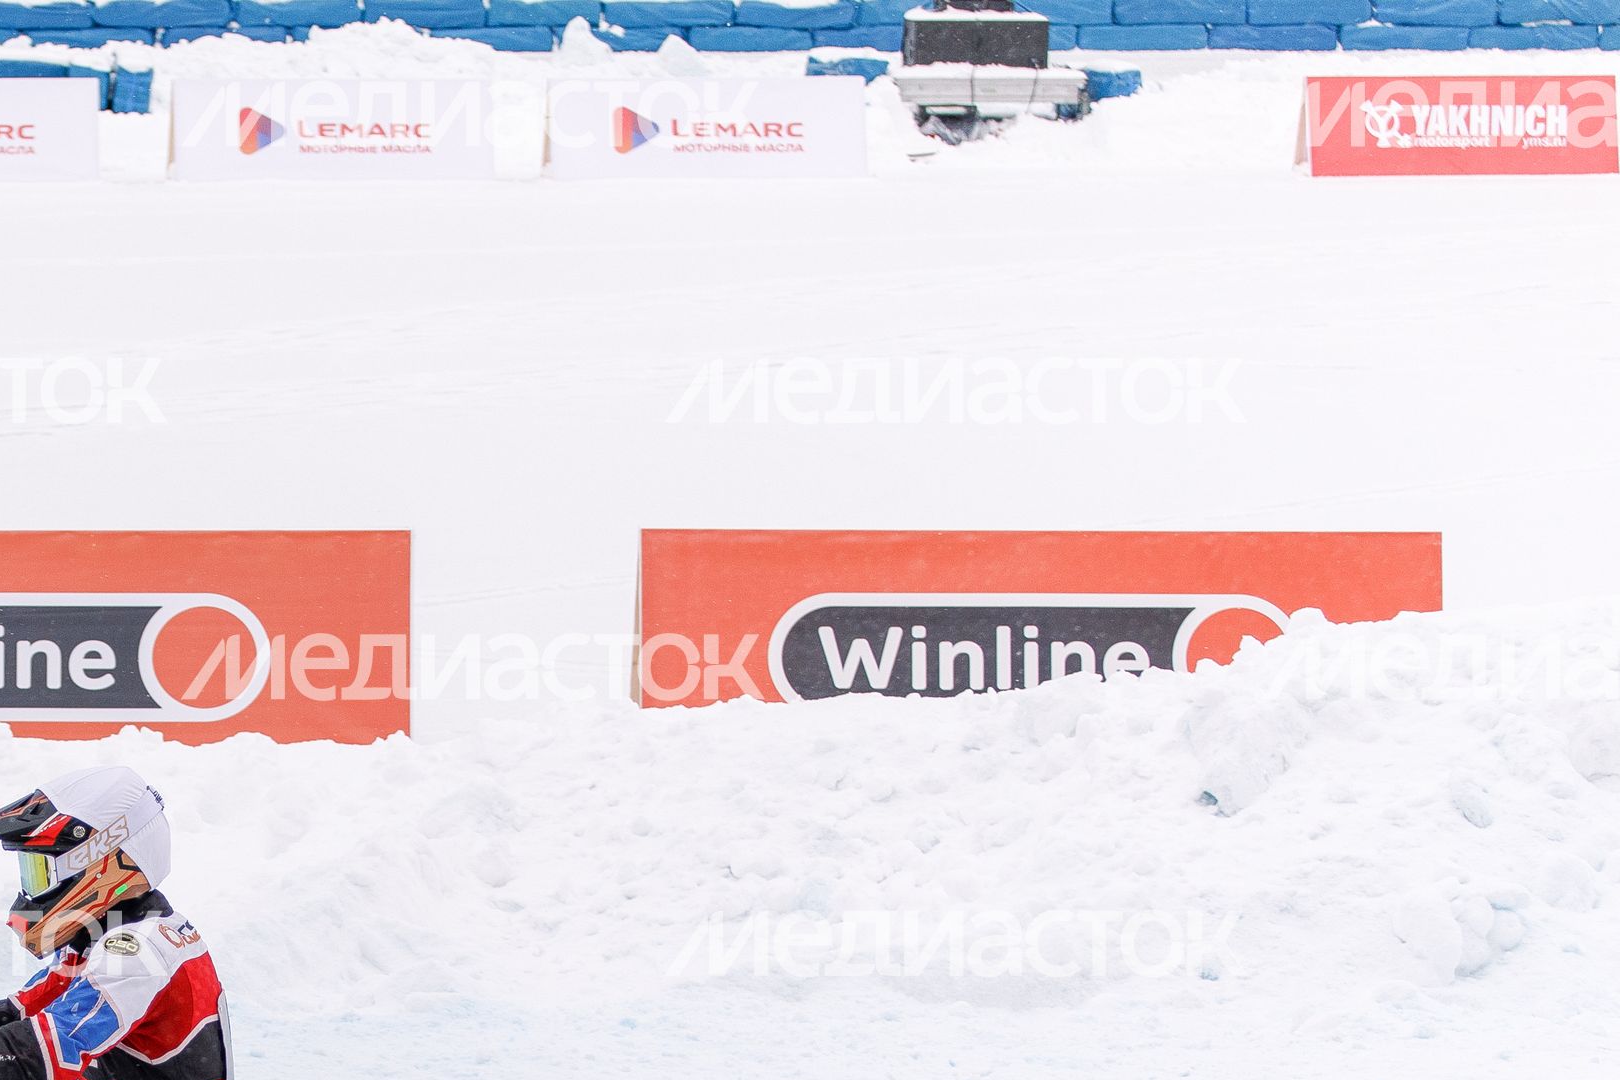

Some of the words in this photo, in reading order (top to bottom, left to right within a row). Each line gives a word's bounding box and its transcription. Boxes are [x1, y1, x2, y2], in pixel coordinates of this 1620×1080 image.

[299, 120, 431, 138] LEMARC
[673, 119, 804, 138] LEMARC
[1412, 104, 1567, 136] YAKHNICH
[1414, 136, 1490, 149] motorsport
[818, 626, 1150, 690] Winline
